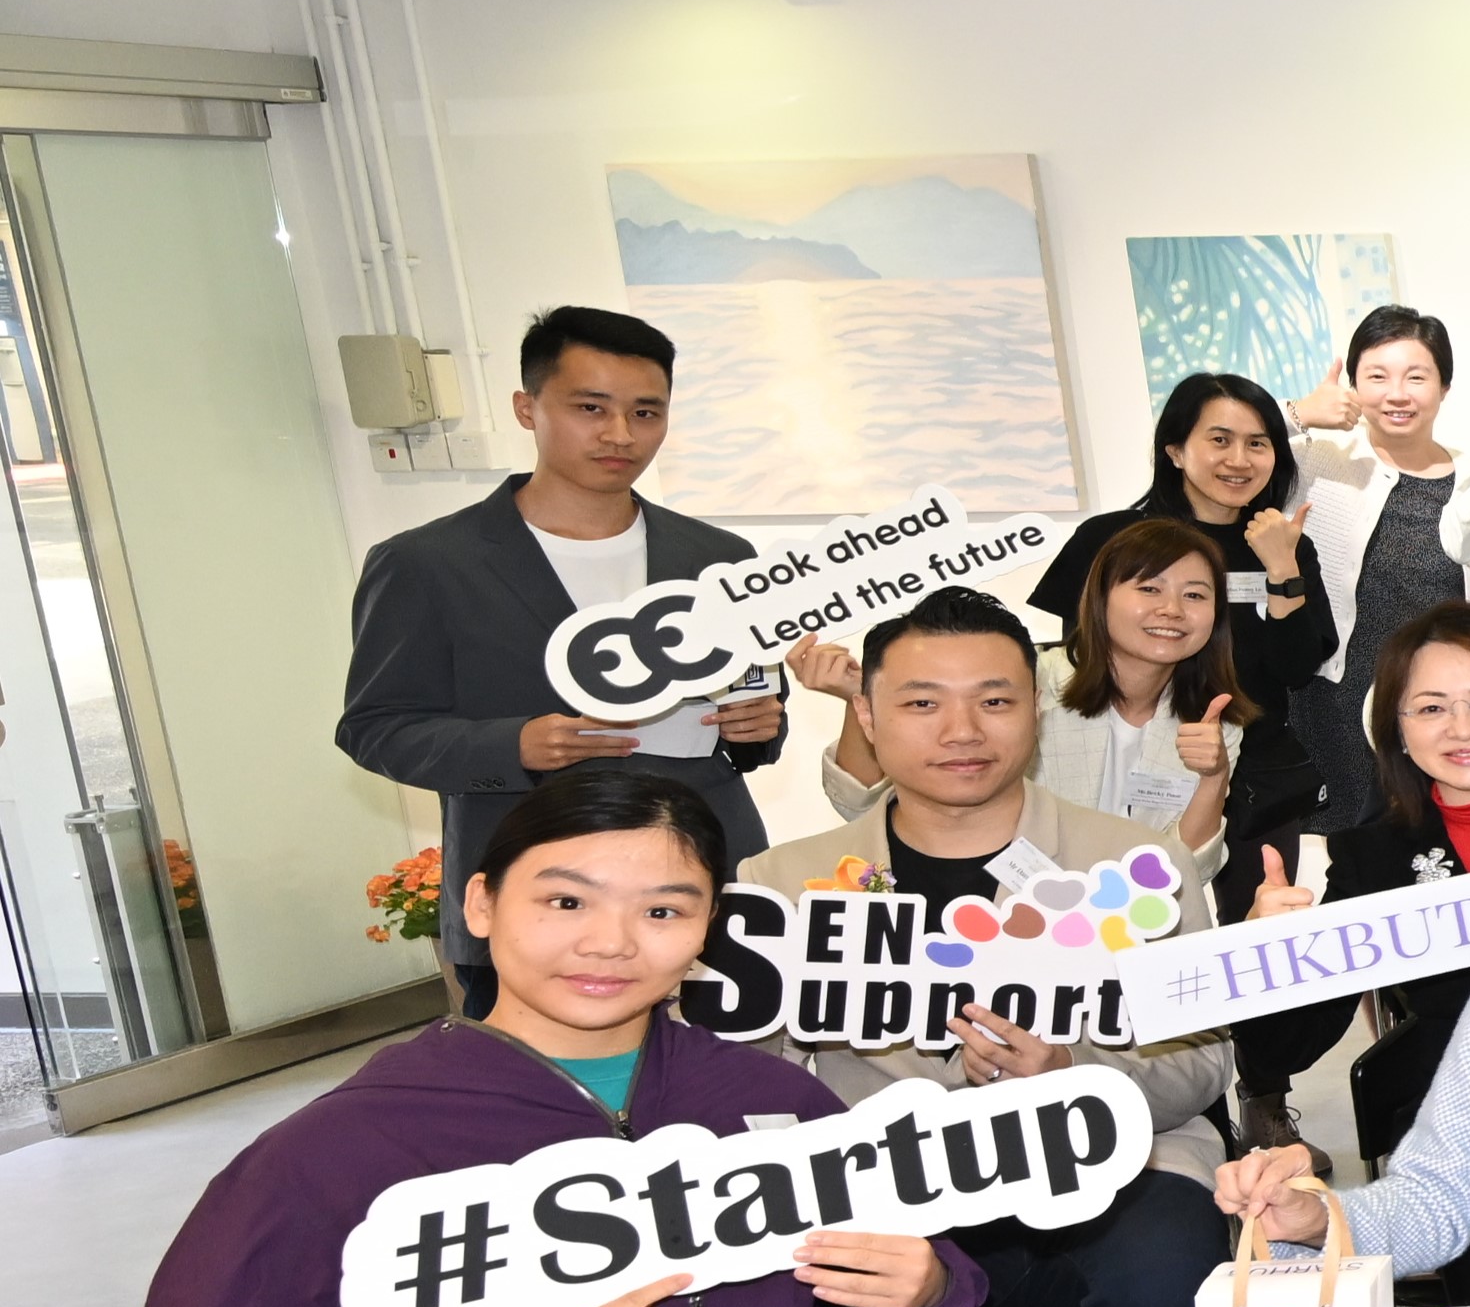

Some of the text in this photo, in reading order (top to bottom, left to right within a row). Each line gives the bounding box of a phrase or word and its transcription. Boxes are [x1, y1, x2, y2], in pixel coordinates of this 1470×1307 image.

[719, 497, 950, 605] Look ahead
[750, 525, 1046, 651] Lead the future
[680, 896, 925, 1035] SEN
